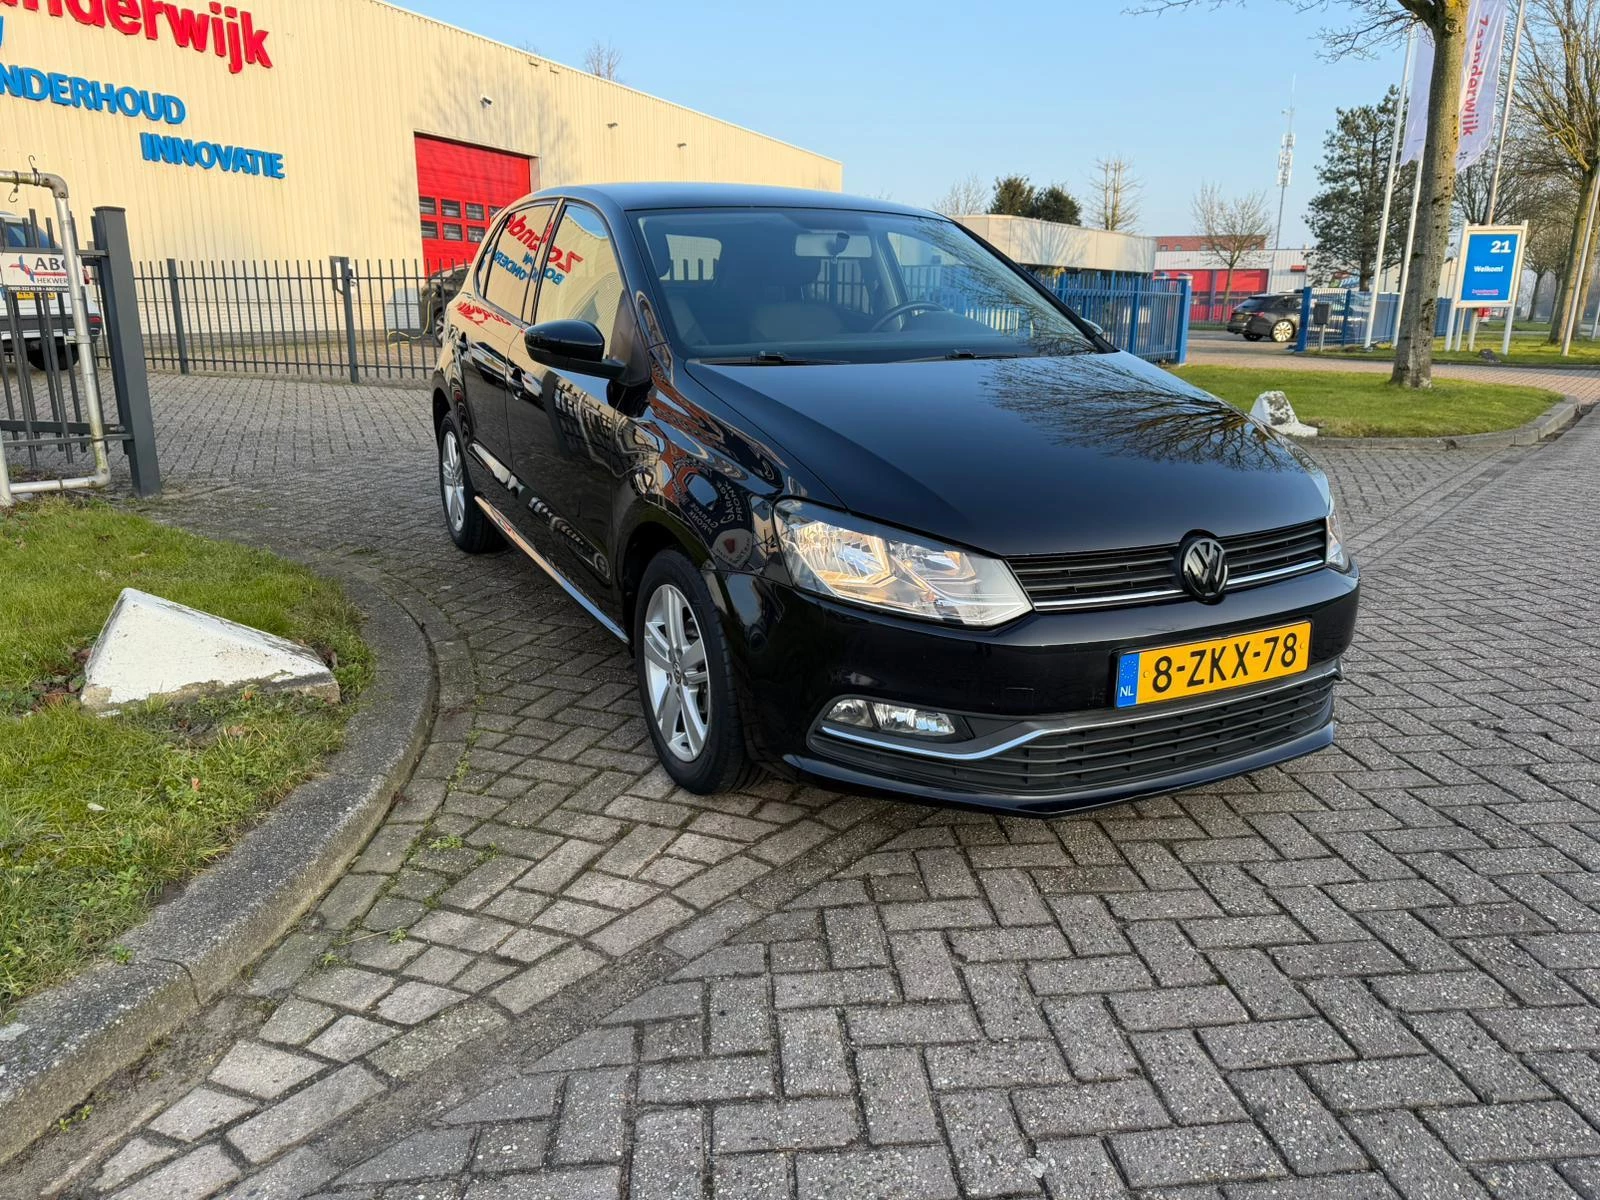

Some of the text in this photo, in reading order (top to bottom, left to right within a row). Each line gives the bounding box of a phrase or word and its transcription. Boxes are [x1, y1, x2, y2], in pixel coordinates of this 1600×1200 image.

[139, 132, 285, 179] INNOVATIE
[1490, 239, 1512, 254] 21
[35, 257, 67, 270] AB
[1473, 265, 1504, 273] Welkom!
[1151, 632, 1298, 693] 8-ZKX-78
[1119, 686, 1134, 697] NL
